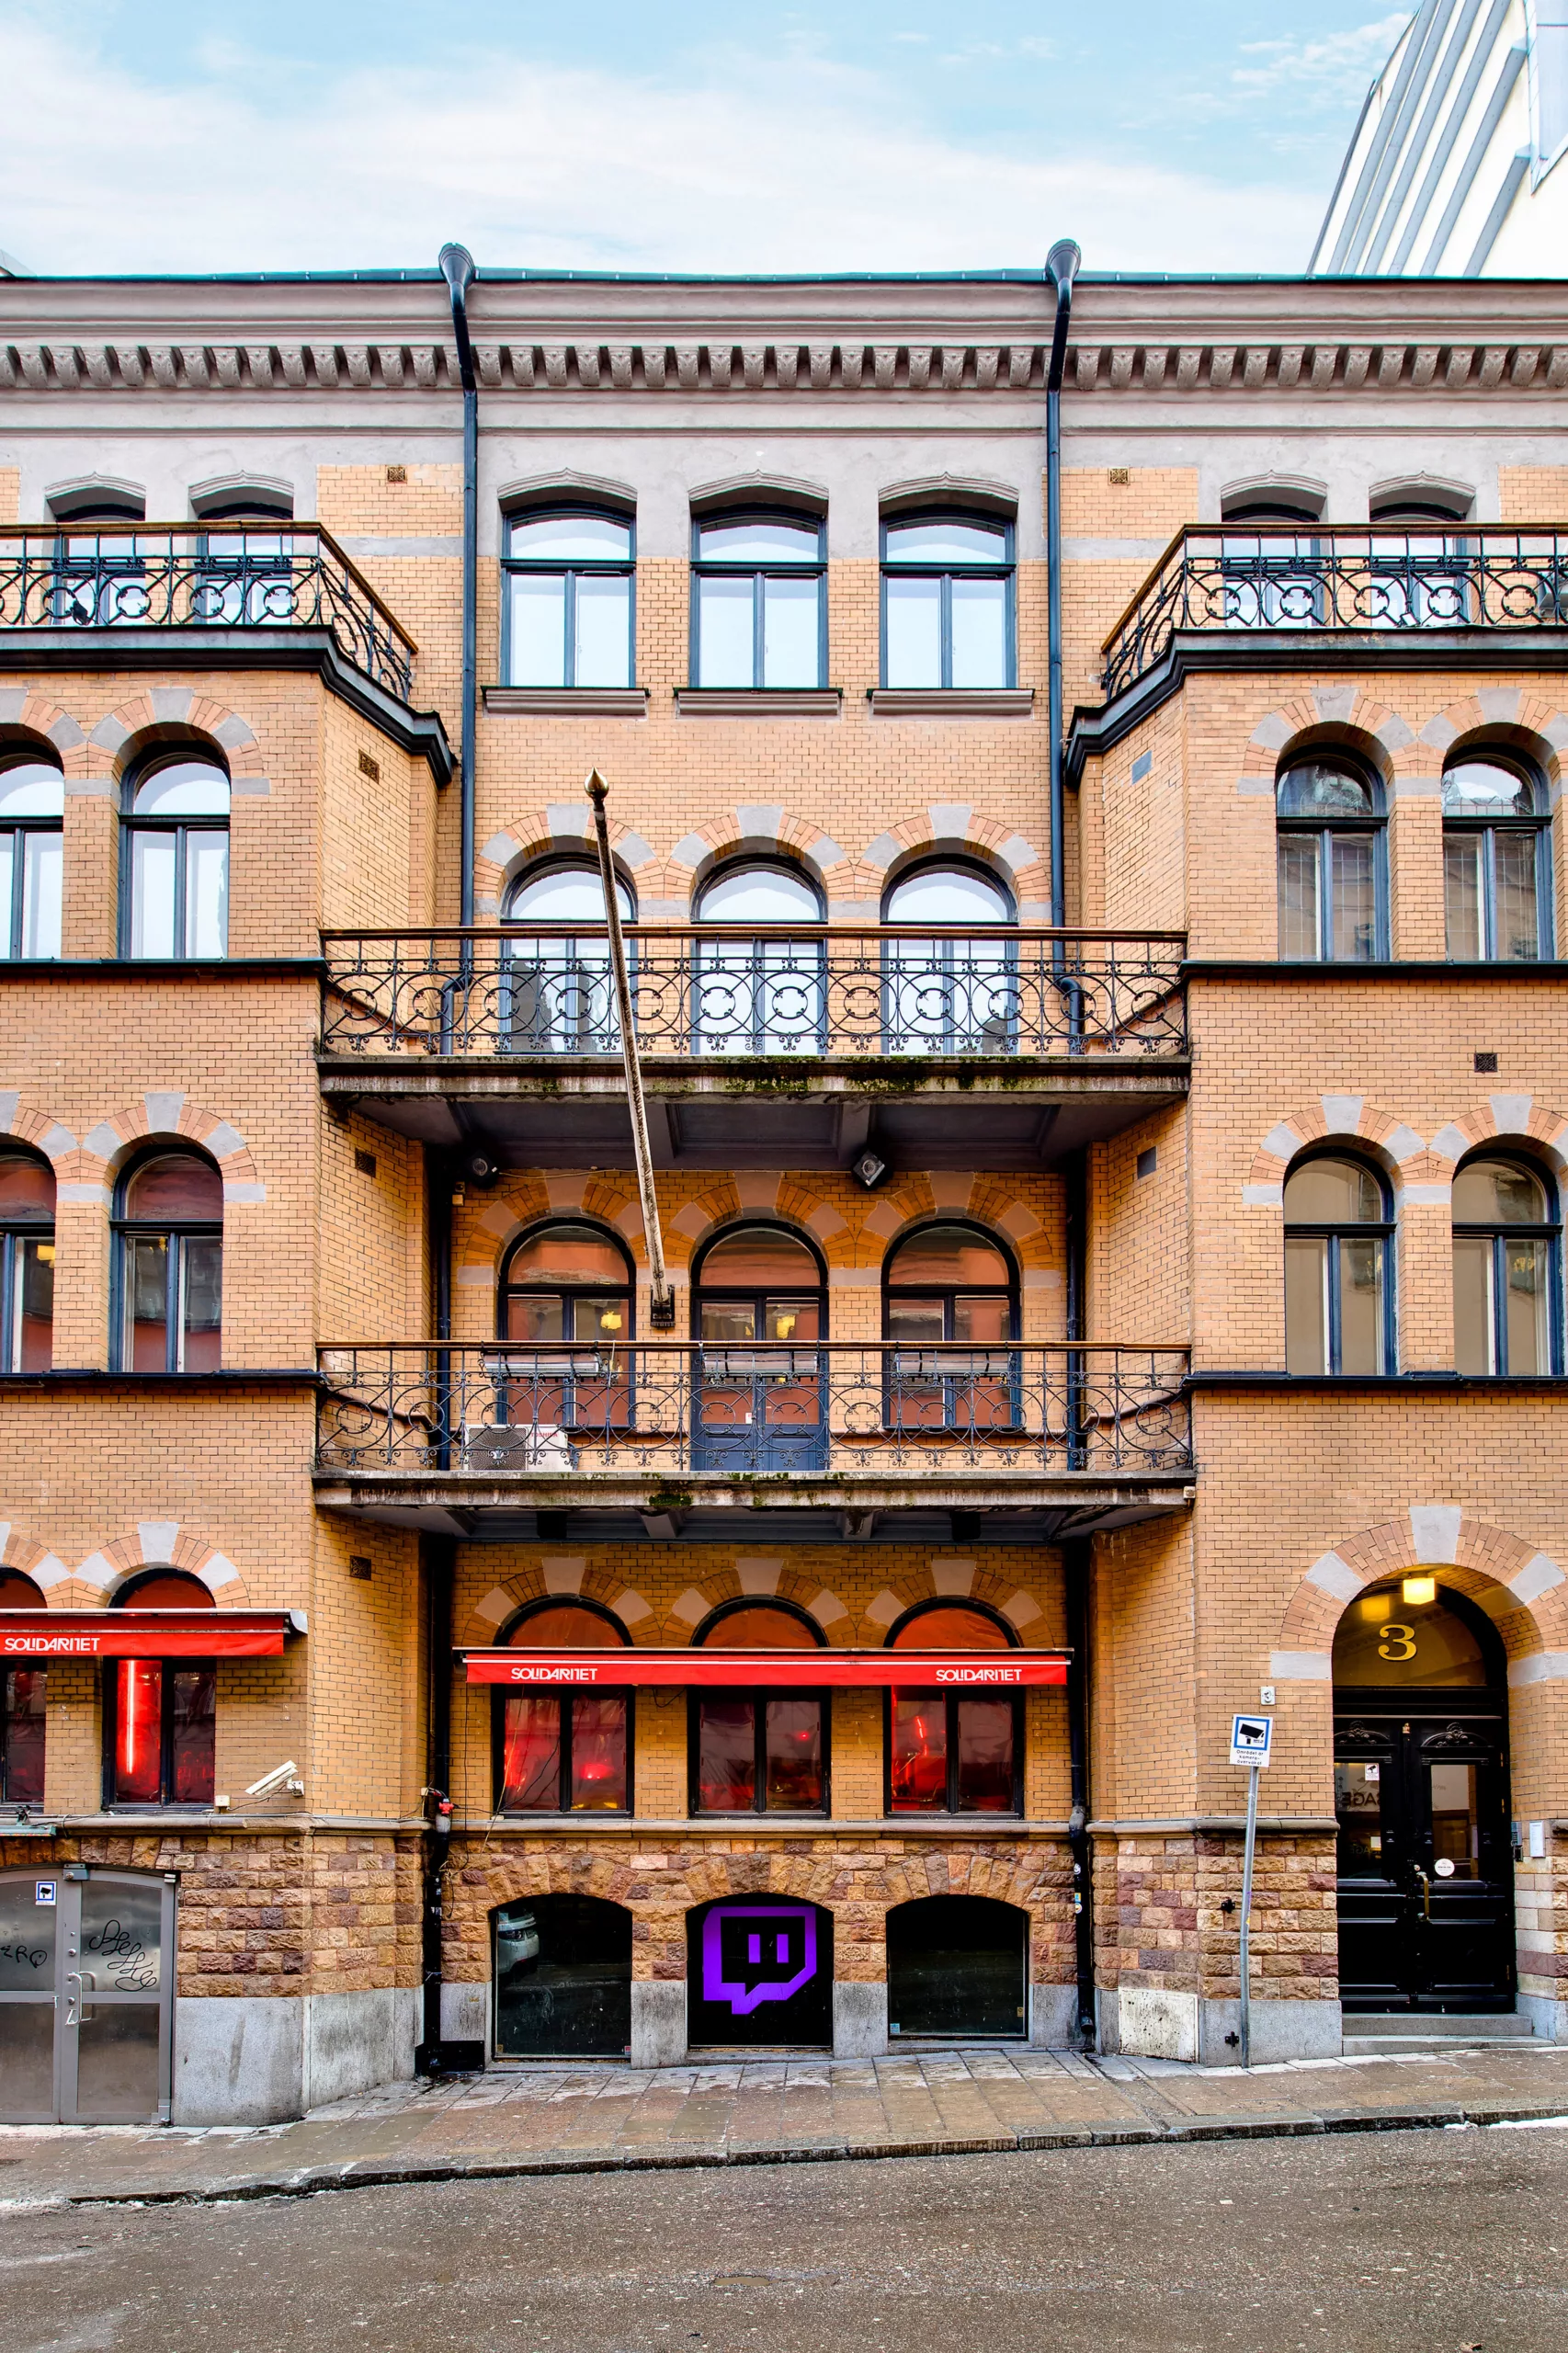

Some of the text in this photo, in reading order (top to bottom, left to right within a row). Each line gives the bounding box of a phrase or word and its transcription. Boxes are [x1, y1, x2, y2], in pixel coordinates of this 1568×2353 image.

[4, 1637, 100, 1652] SOLIDARITET
[1378, 1623, 1416, 1661] 3
[510, 1667, 597, 1681] SOLIDARITET
[936, 1669, 1022, 1682] SOLIDARITET
